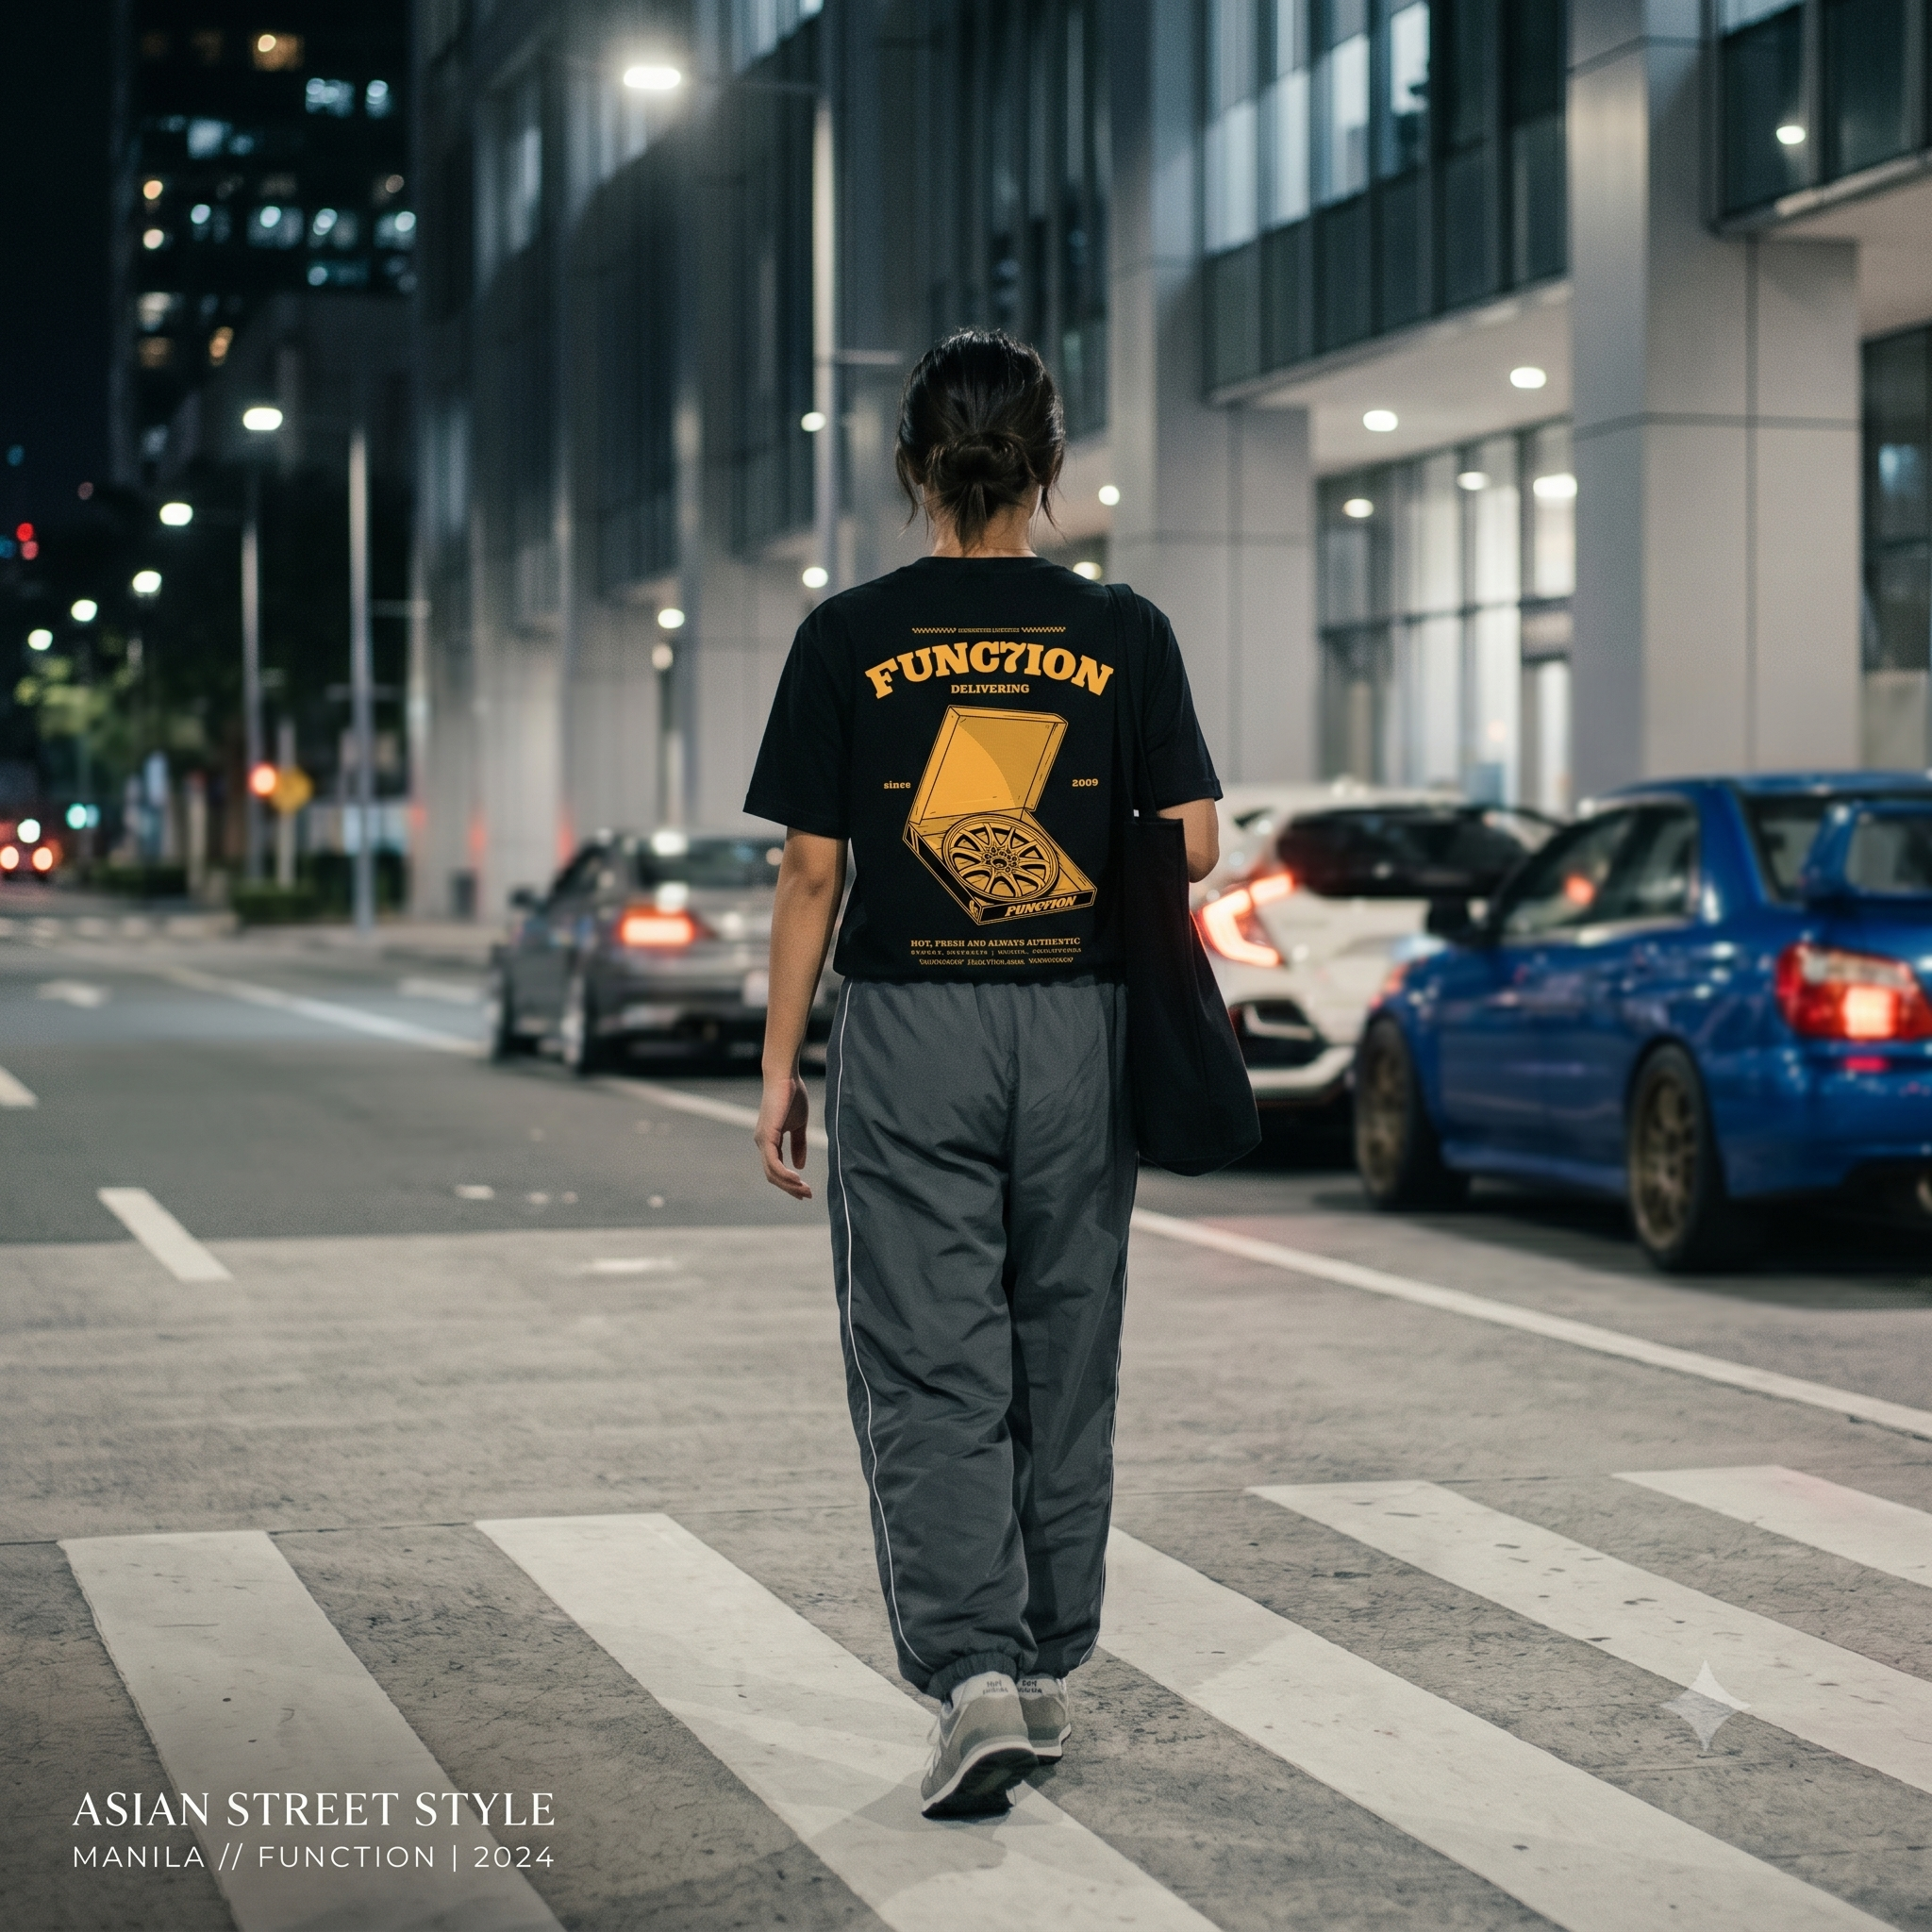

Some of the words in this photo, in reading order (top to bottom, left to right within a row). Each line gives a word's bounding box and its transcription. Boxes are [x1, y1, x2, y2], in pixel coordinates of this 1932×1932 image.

[951, 684, 1029, 693] DELIVERING
[883, 780, 911, 790] since
[1072, 778, 1099, 788] 2009
[910, 940, 932, 948] HOT,
[988, 939, 1025, 947] ALWAYS
